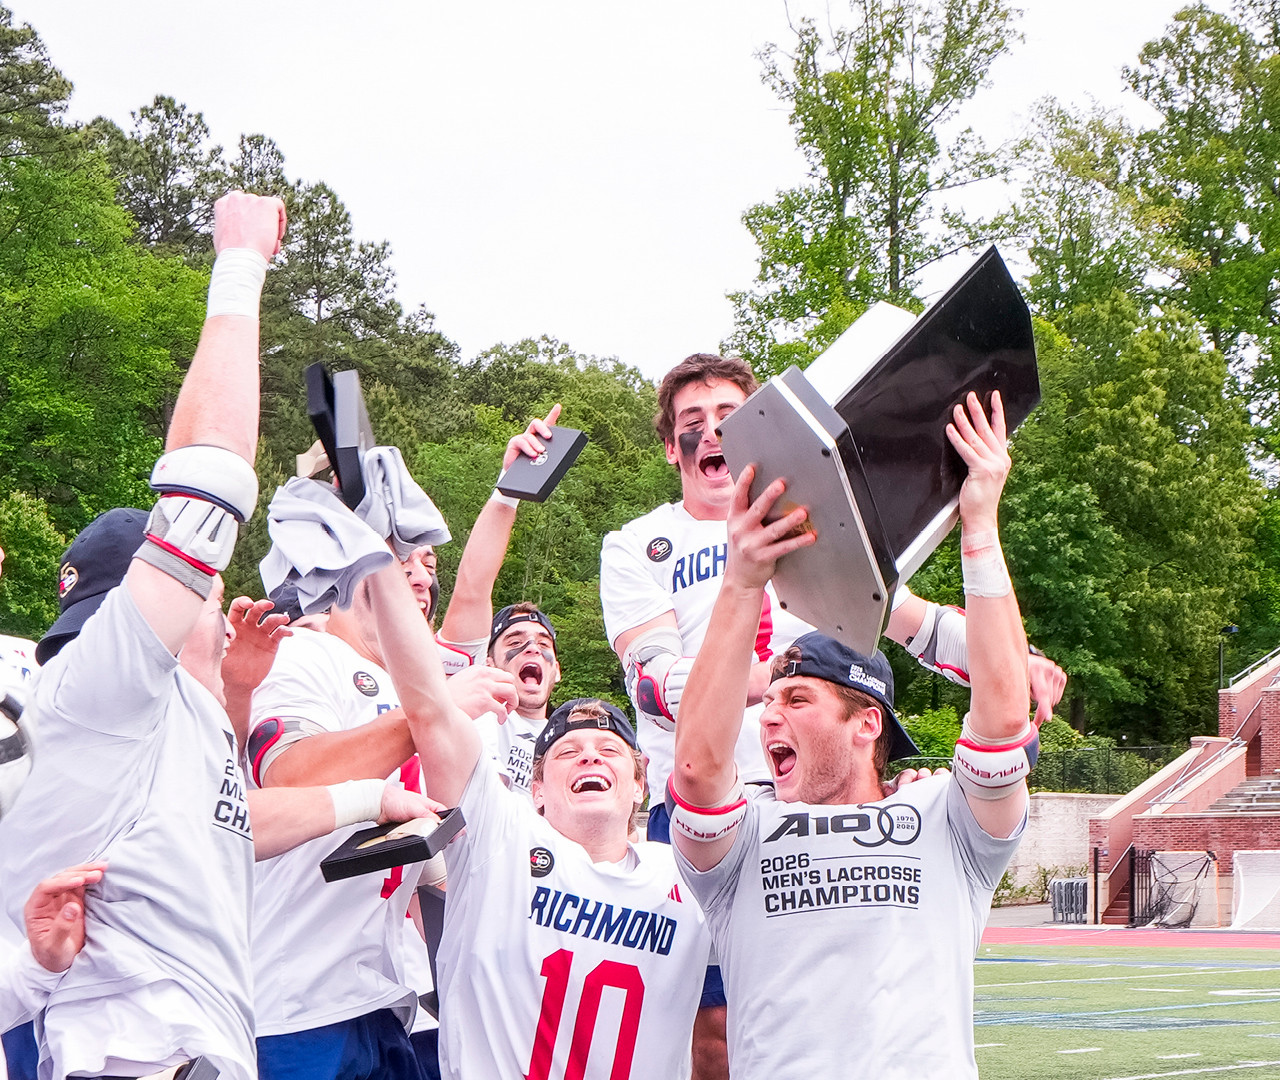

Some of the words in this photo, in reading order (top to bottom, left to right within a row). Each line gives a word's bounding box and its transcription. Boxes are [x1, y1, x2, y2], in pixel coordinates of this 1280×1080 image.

[762, 813, 871, 844] A10
[761, 853, 810, 874] 2026
[762, 869, 821, 891] MEN'S
[826, 866, 922, 884] LACROSSE
[764, 884, 920, 913] CHAMPIONS
[528, 886, 678, 956] RICHMOND
